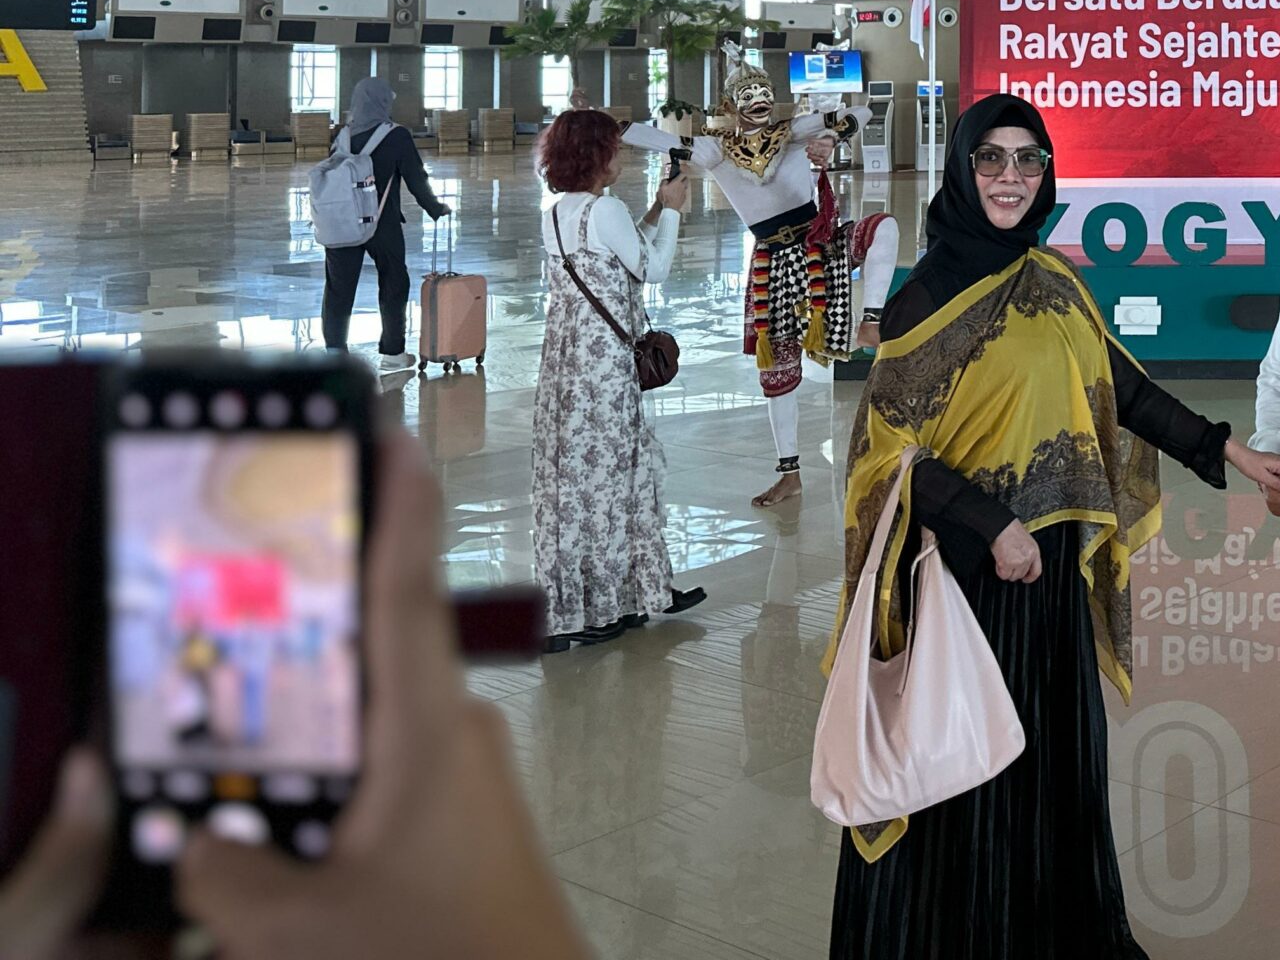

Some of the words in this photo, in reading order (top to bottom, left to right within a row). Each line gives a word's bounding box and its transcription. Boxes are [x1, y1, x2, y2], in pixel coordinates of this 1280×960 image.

[1000, 23, 1128, 69] Rakyat
[1000, 70, 1181, 108] Indonesia
[1193, 69, 1278, 117] Maju
